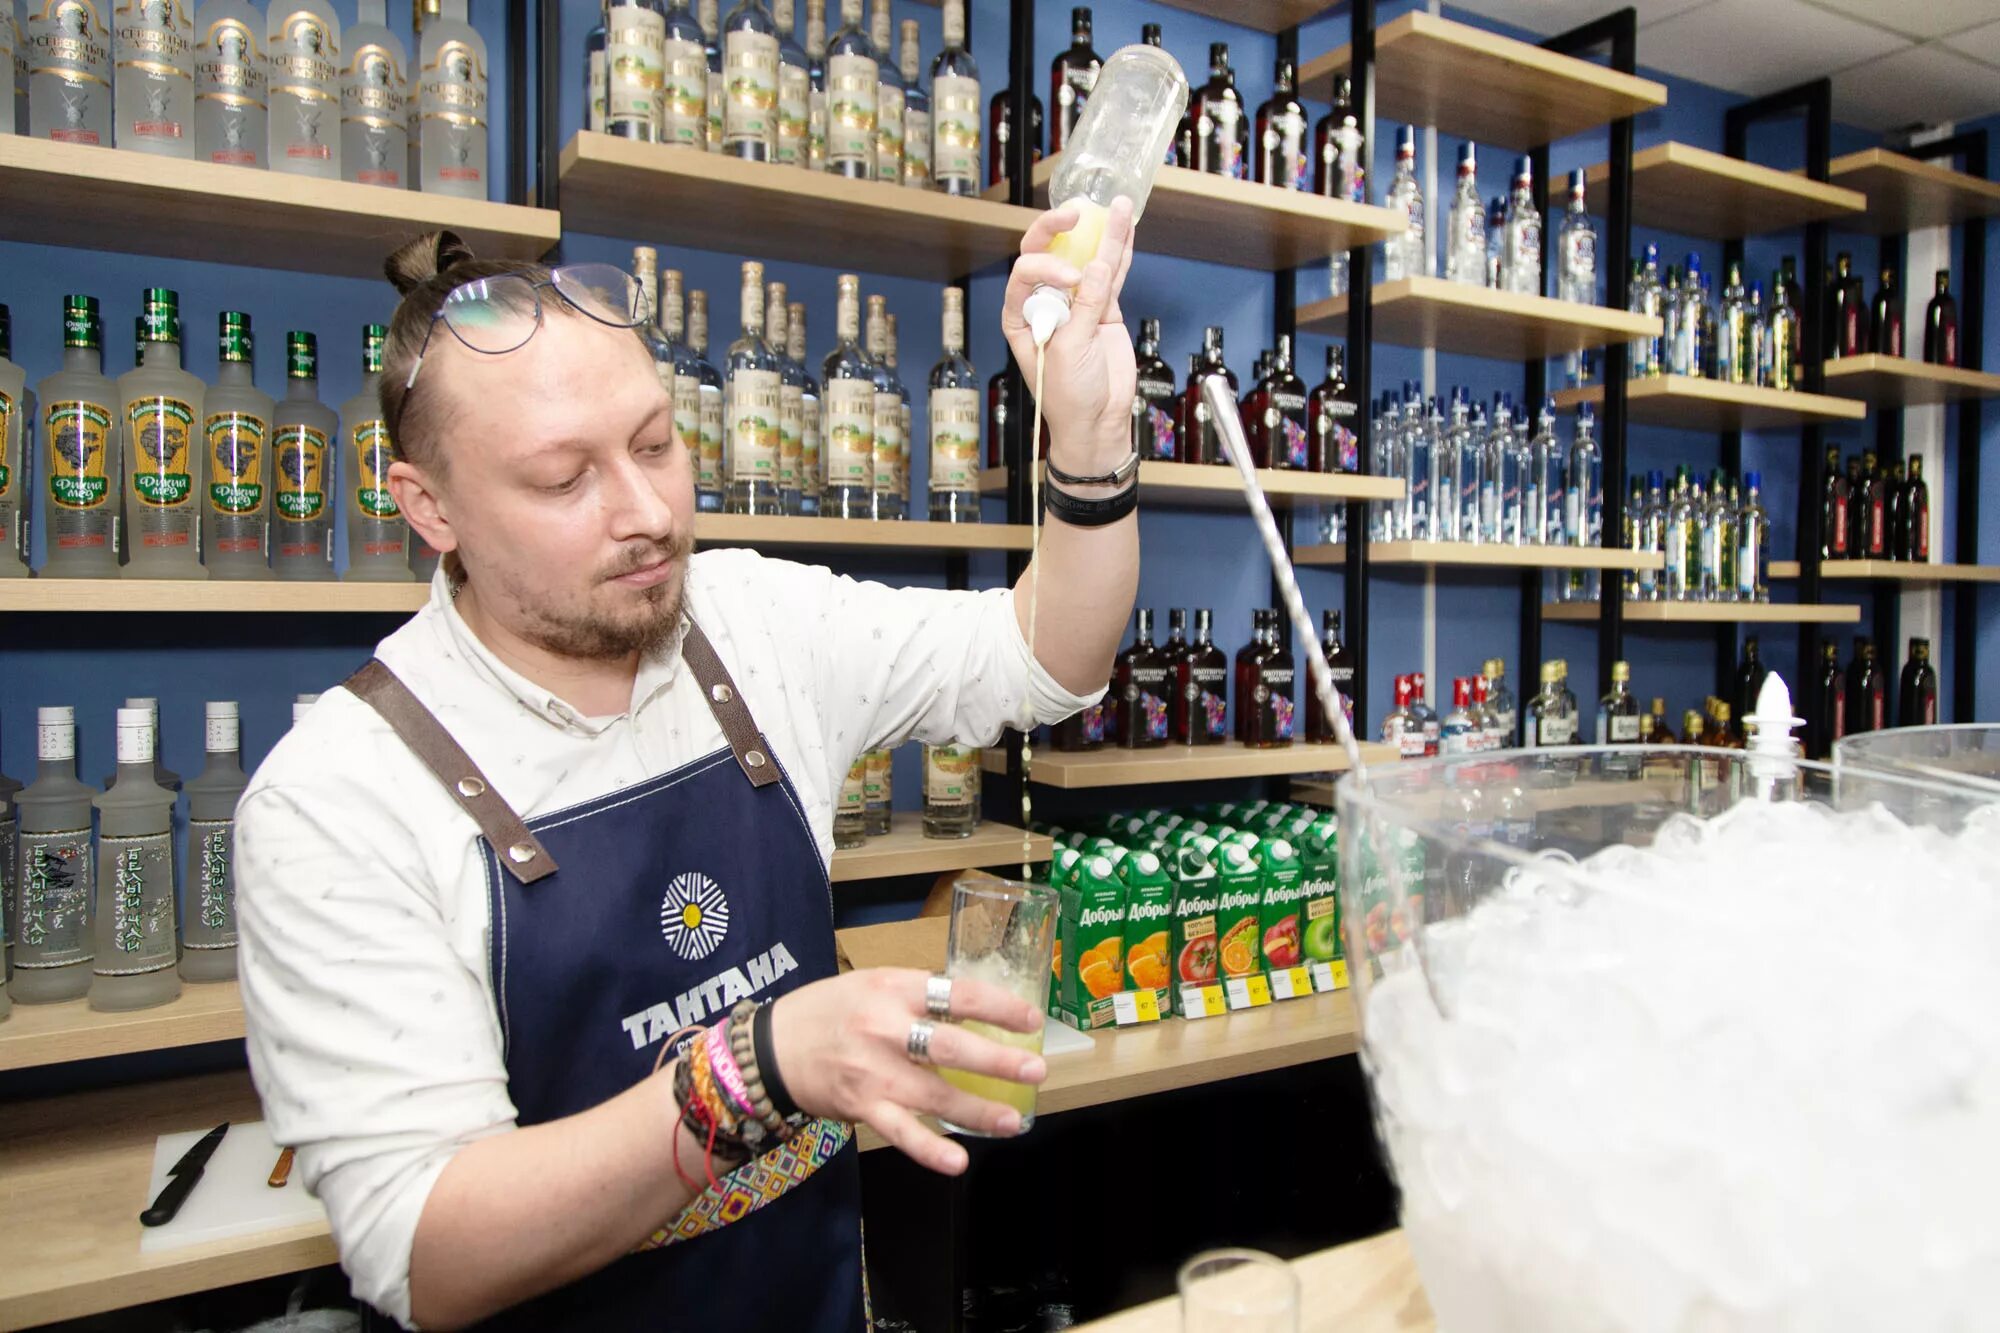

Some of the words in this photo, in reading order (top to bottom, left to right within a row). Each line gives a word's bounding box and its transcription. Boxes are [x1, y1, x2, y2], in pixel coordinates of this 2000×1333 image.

[56, 477, 103, 491] Дикий
[1263, 885, 1301, 906] Добры
[1301, 877, 1337, 898] Добры
[621, 942, 799, 1050] ТАНТАНА
